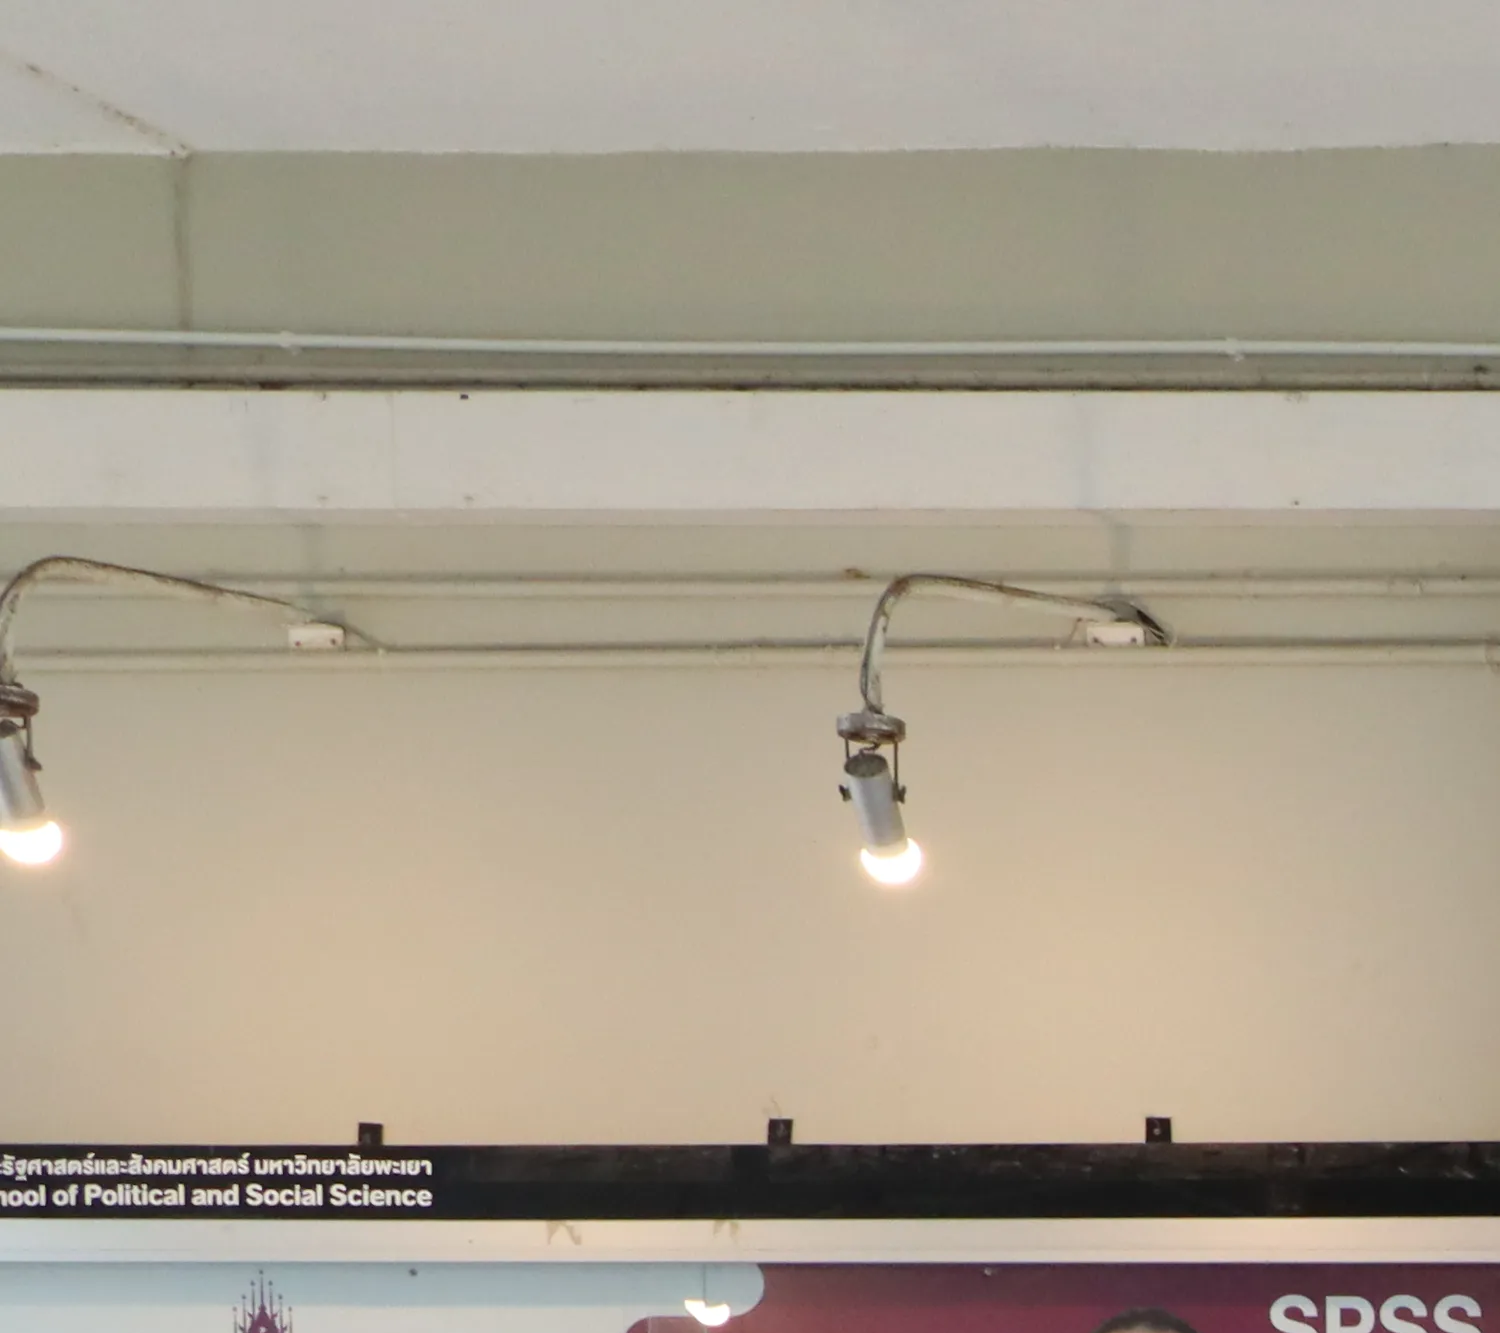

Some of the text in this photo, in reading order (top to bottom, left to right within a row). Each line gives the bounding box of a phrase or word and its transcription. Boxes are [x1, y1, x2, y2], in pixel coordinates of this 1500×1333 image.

[0, 1152, 433, 1181] รัฐศาสตร์และสังคมศาสตร์ มหาวิทยาลัยพะเยา
[52, 1183, 79, 1207] of
[84, 1183, 186, 1207] Political
[191, 1183, 240, 1207] and
[246, 1183, 323, 1207] Social
[330, 1184, 433, 1207] Science
